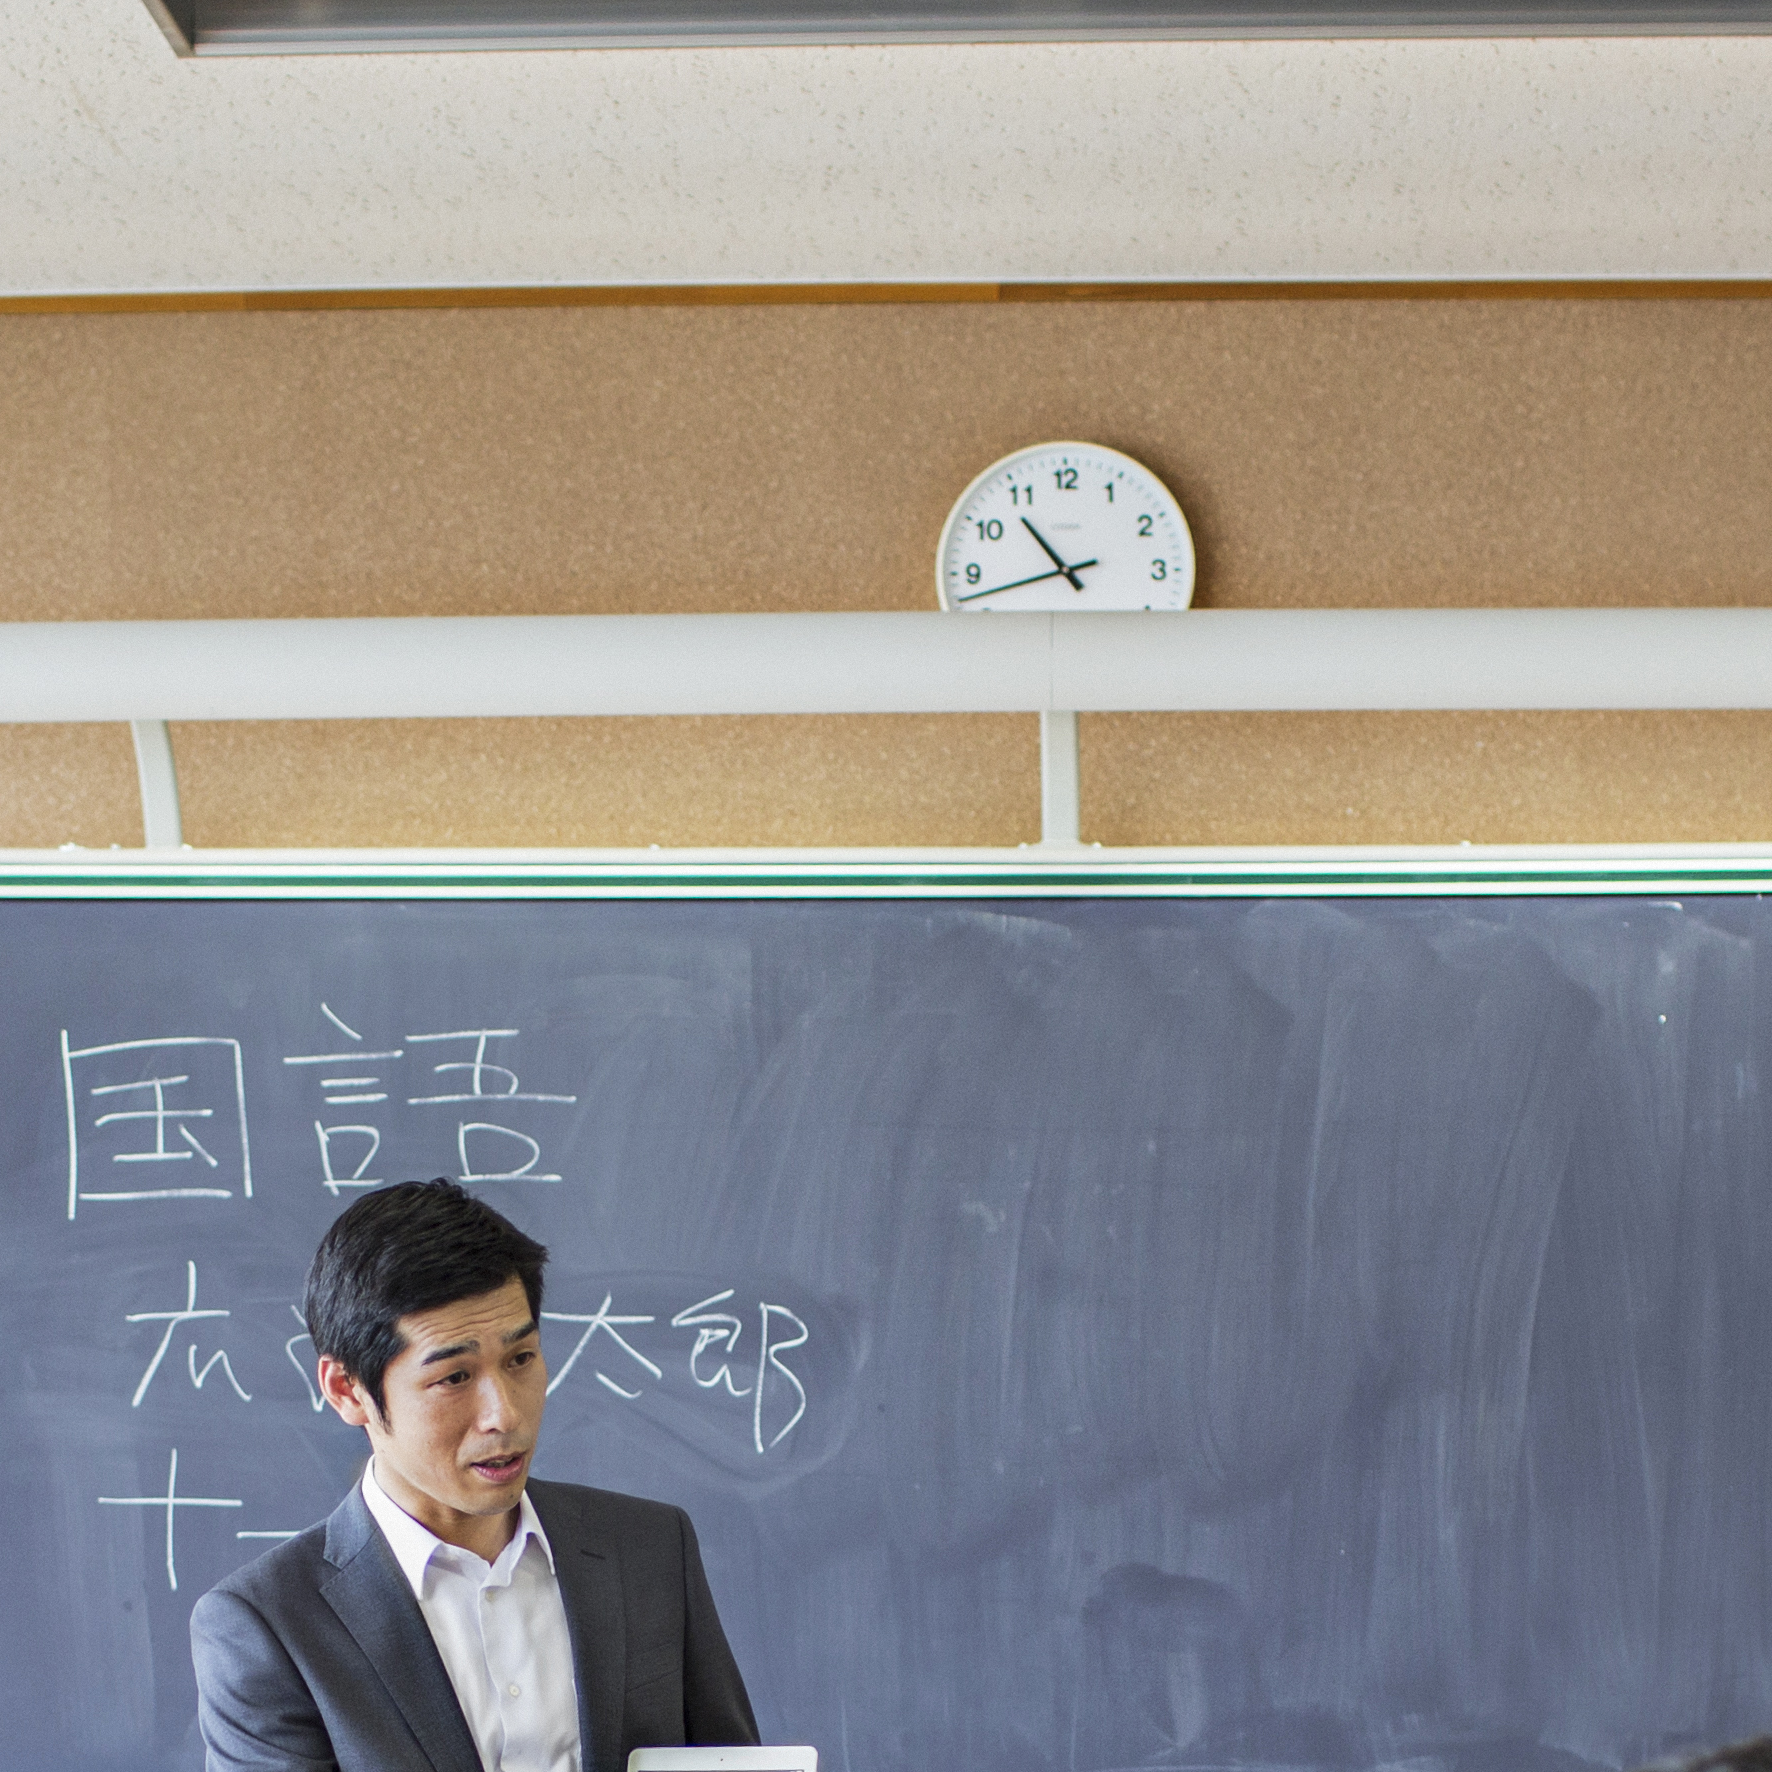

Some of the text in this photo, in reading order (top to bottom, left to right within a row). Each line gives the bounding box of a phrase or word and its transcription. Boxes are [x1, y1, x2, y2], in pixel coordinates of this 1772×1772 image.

[1053, 467, 1079, 491] 12
[1008, 484, 1034, 507] 11
[1104, 481, 1115, 504] 1
[975, 518, 1005, 541] 10
[1137, 513, 1154, 538] 2
[965, 562, 982, 585] 9
[1150, 559, 1167, 581] 3
[60, 1001, 578, 1221] 国語
